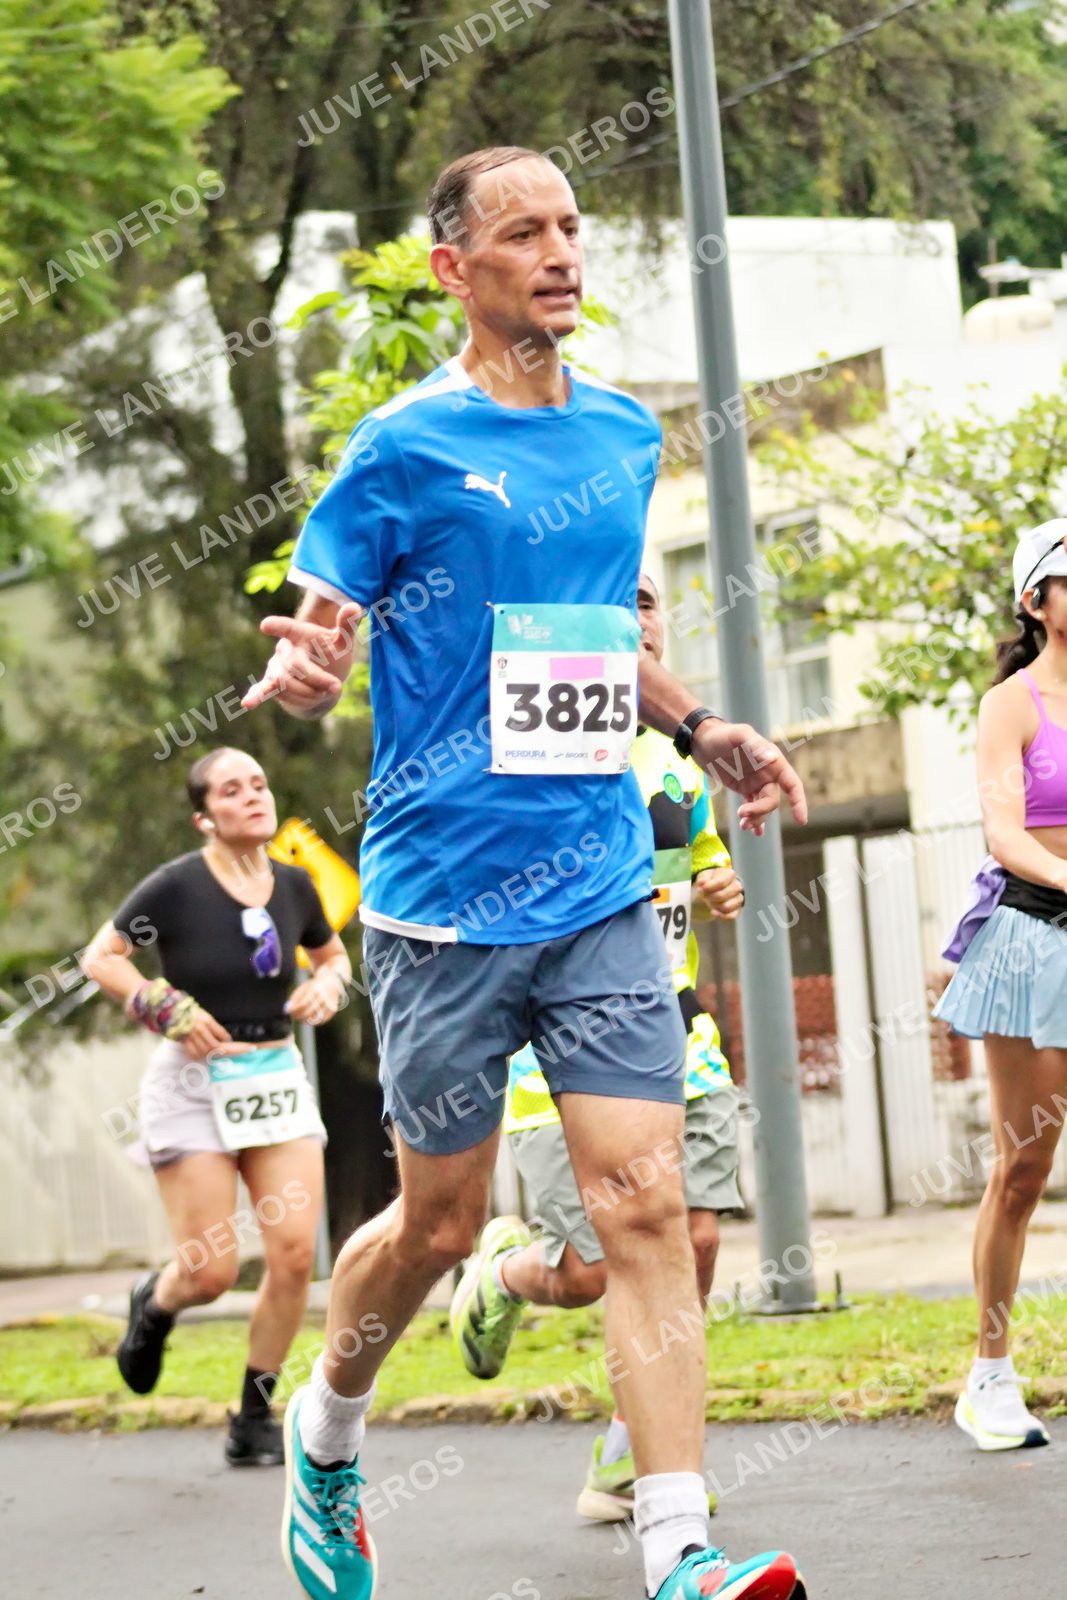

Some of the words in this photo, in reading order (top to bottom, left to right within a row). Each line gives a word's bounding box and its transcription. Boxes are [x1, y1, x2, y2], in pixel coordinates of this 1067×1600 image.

[504, 682, 632, 733] 3825
[504, 750, 547, 758] PERDURA
[224, 1088, 298, 1124] 6257
